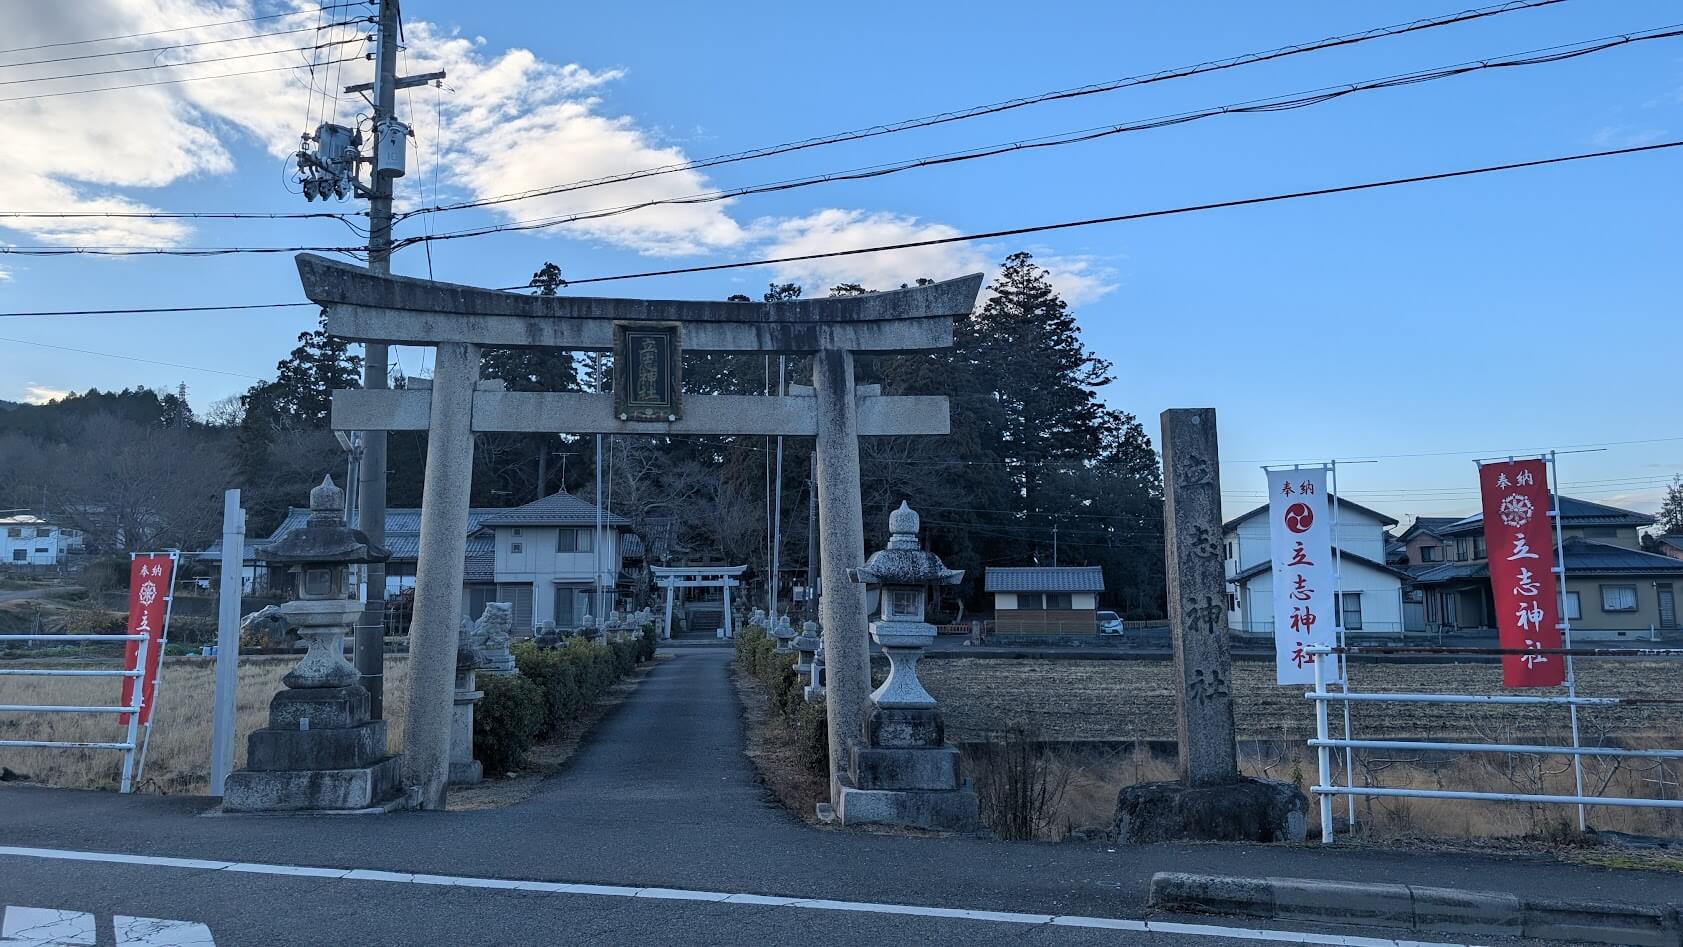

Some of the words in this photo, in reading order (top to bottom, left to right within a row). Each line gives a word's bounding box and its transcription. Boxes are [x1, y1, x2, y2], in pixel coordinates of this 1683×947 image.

[1280, 479, 1315, 497] 奉納
[1496, 469, 1533, 490] 奉納
[139, 564, 162, 577] 奉納
[1287, 541, 1317, 669] 立志神社
[1506, 533, 1547, 669] 立志神社
